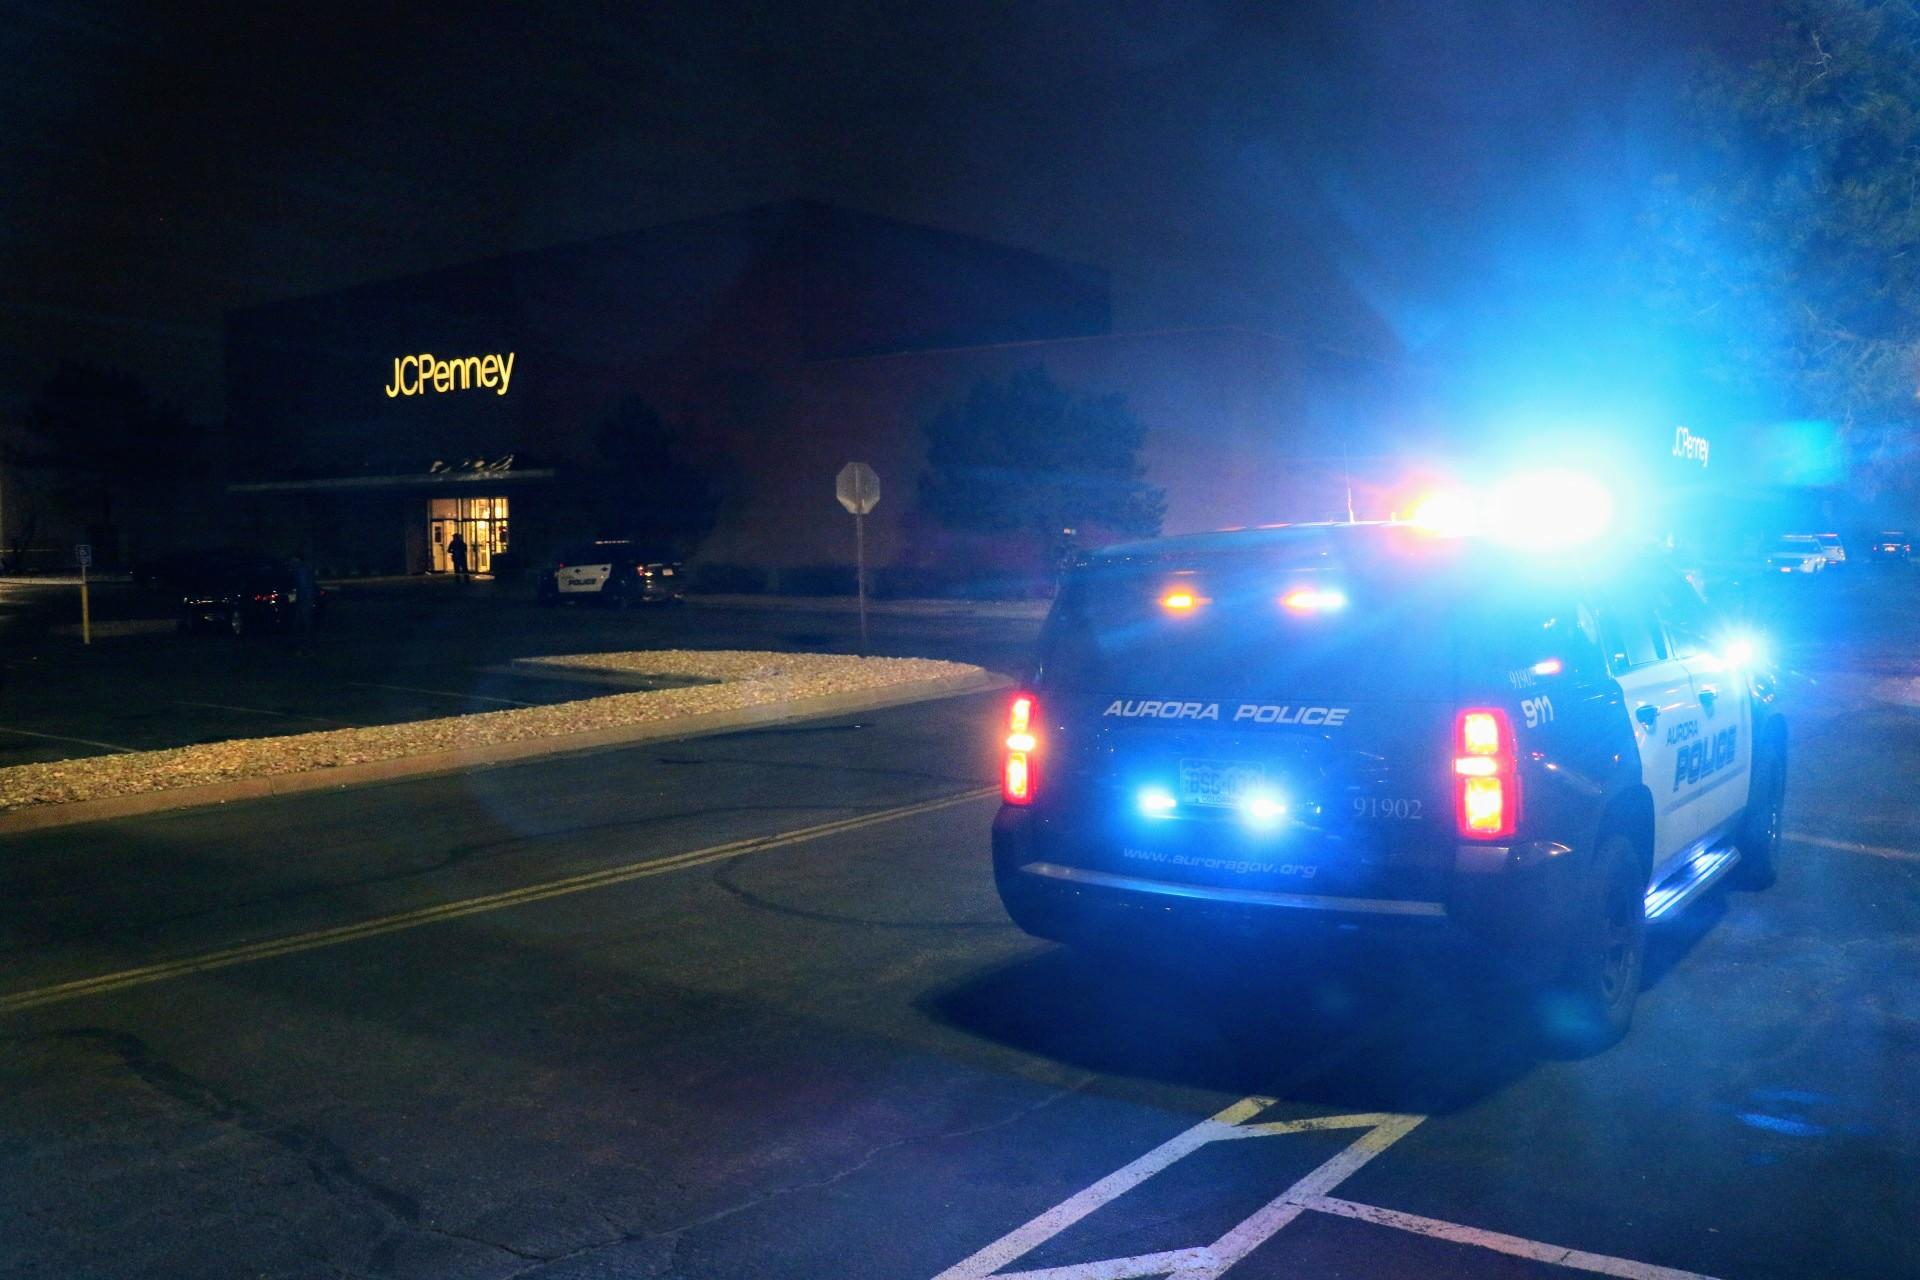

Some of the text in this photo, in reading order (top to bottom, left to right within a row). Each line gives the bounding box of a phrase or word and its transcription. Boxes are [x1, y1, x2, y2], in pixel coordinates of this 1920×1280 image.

[385, 352, 515, 398] JCPenney
[568, 577, 597, 586] POLICE
[1103, 700, 1349, 727] AURORA POLICE
[1521, 695, 1554, 728] 911
[1666, 719, 1698, 747] AURORA
[1673, 724, 1737, 793] POLICE
[1353, 796, 1423, 820] 91902
[1123, 847, 1319, 879] www.auroragov.org
